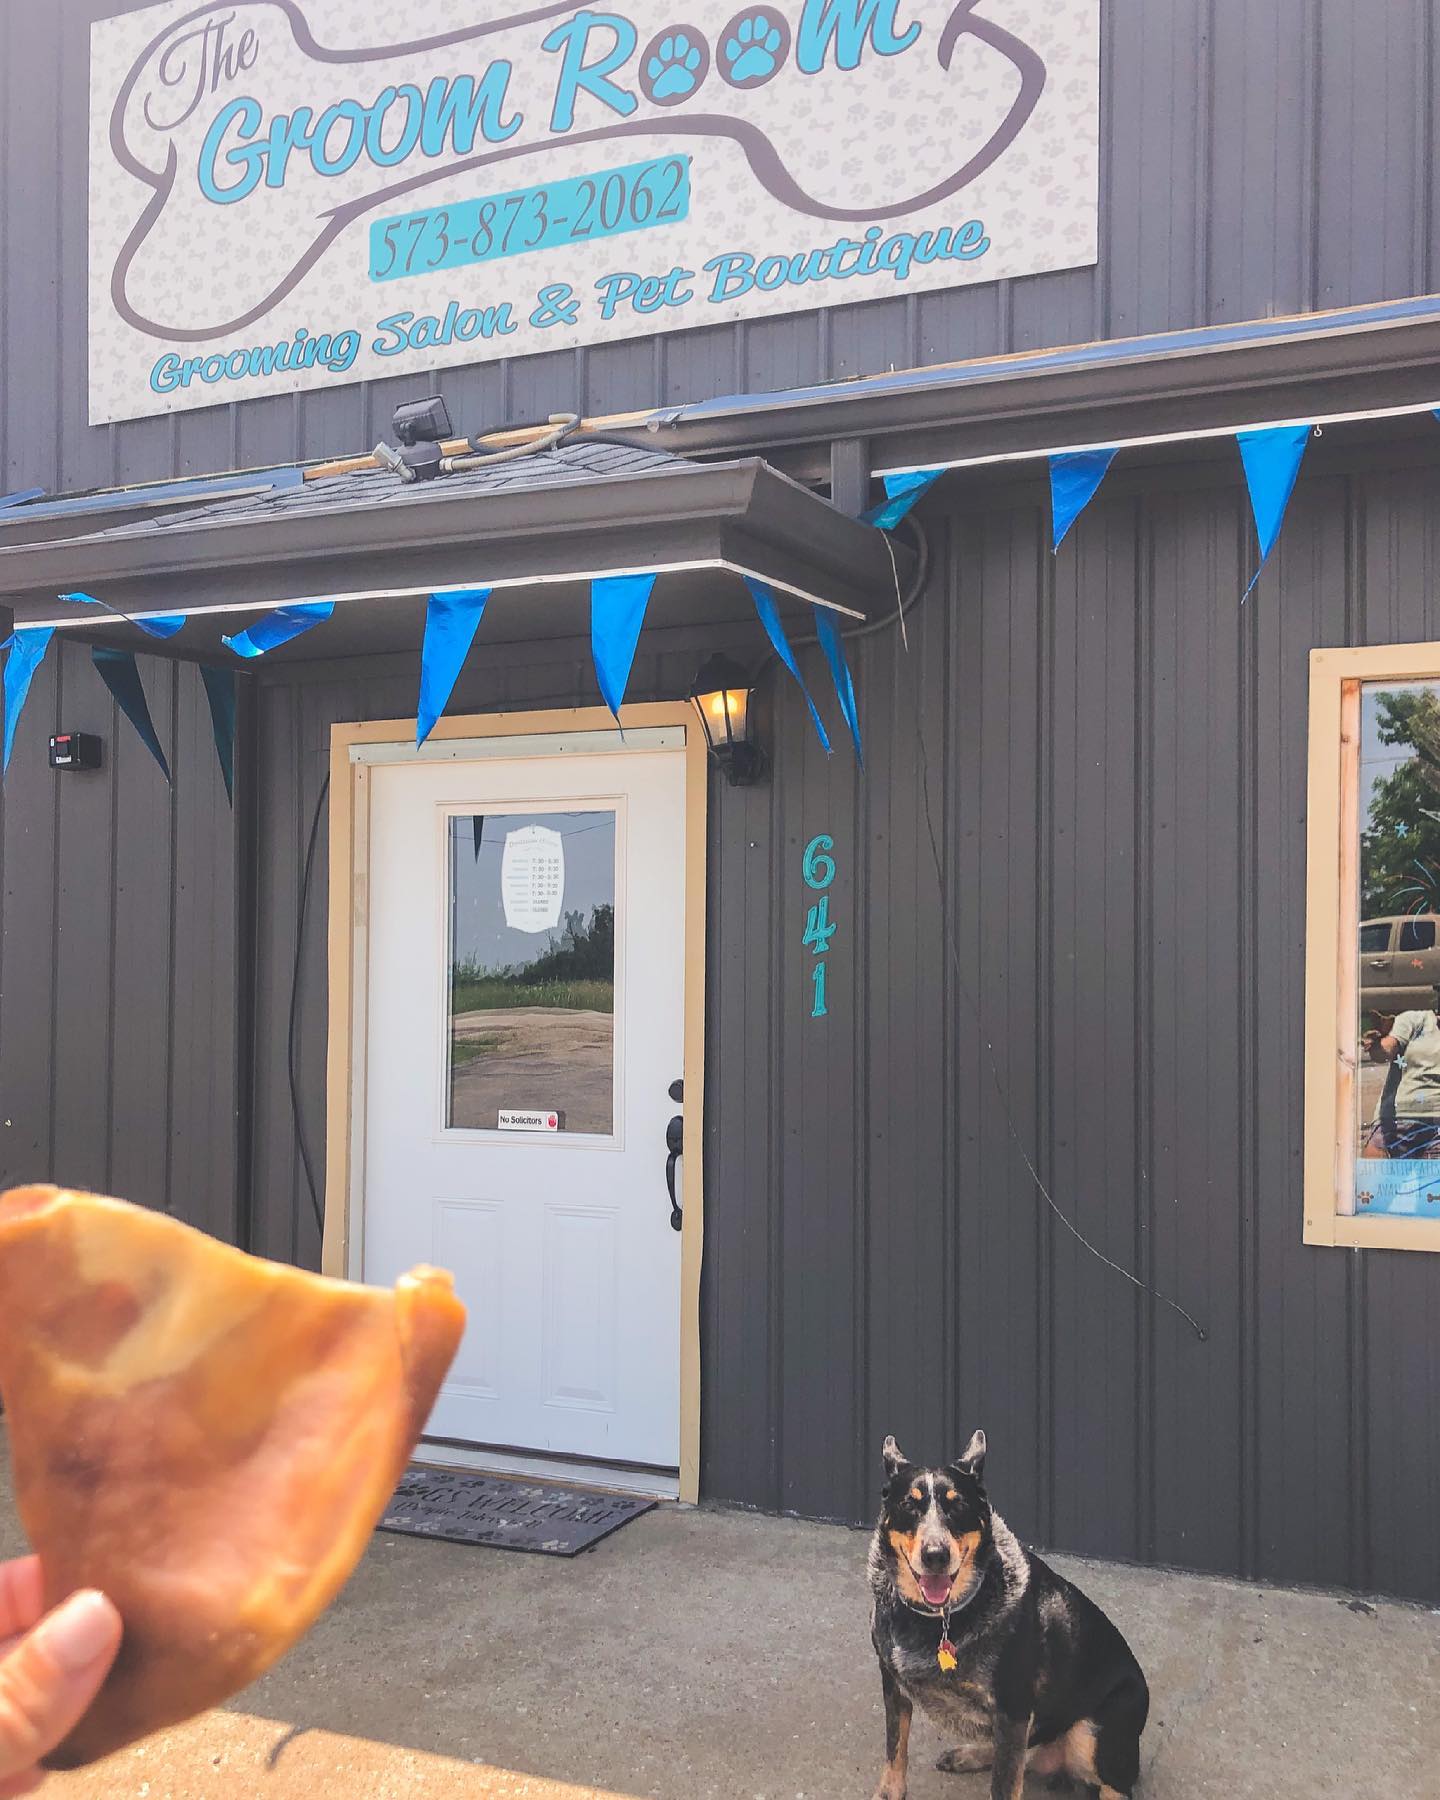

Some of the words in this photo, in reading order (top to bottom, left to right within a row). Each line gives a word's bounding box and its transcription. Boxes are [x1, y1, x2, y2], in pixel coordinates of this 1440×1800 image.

[144, 10, 259, 131] The
[197, 59, 523, 205] Groom
[541, 0, 922, 134] Room
[375, 155, 693, 279] 573-873-2062
[149, 328, 361, 394] Grooming
[371, 301, 518, 356] Salon
[529, 283, 580, 329] &
[594, 266, 695, 320] Pet
[702, 219, 992, 304] Boutique
[801, 833, 838, 1018] 641
[500, 1115, 509, 1123] No
[510, 1115, 542, 1125] Solicitors
